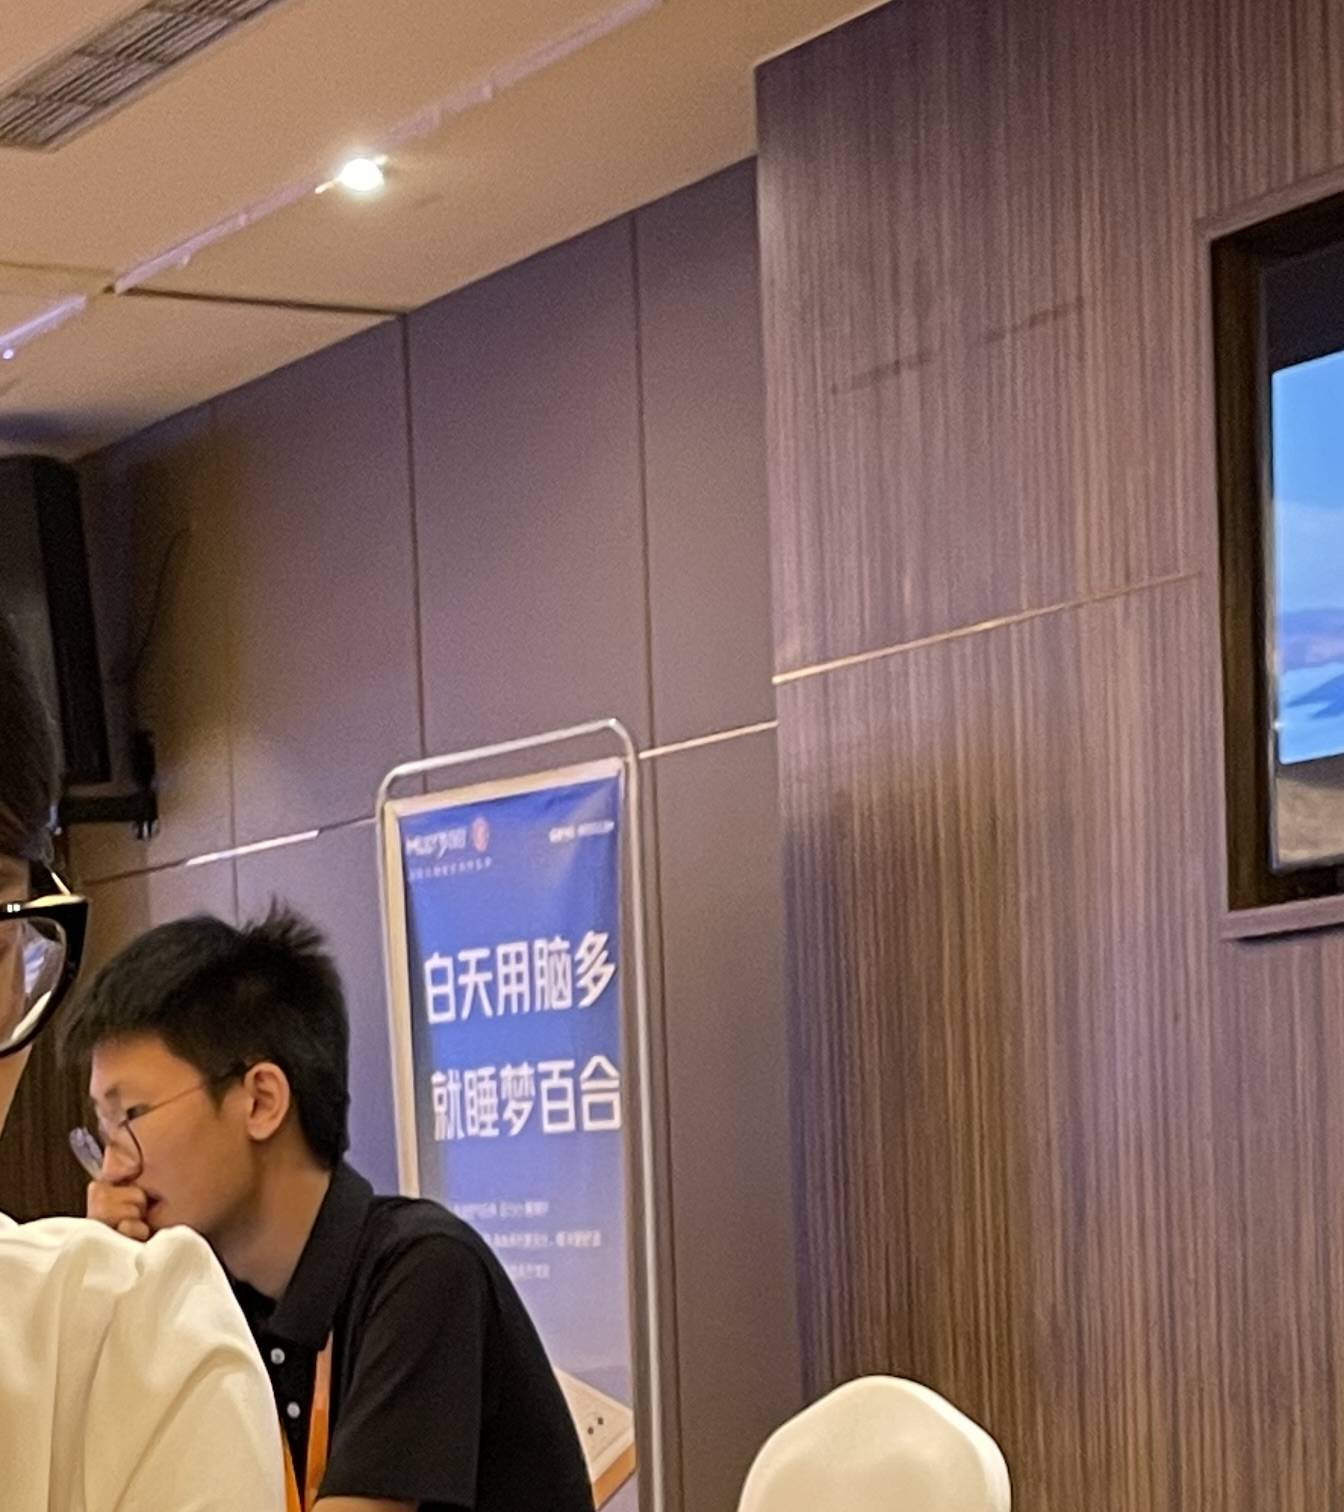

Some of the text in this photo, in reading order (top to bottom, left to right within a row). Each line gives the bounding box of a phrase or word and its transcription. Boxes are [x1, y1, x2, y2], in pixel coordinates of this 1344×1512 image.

[423, 930, 617, 1024] 白天用脑多
[431, 1055, 622, 1142] 就睡梦百合
